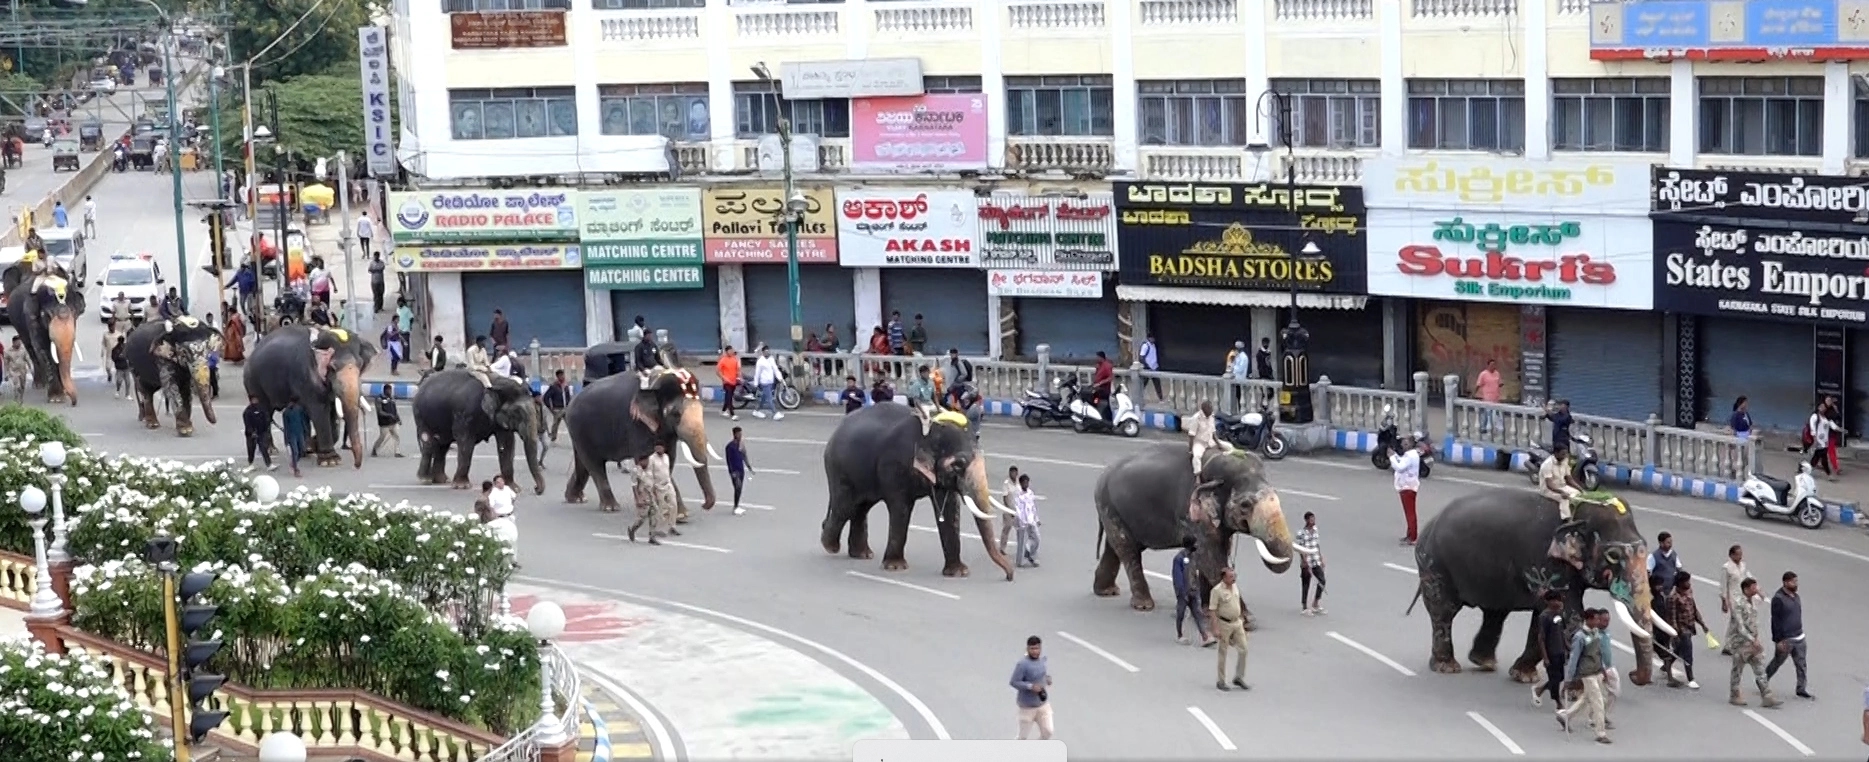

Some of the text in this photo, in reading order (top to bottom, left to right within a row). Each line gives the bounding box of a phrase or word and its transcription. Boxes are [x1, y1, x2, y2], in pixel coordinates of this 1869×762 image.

[370, 92, 386, 156] KSIC
[1740, 177, 1869, 212] ಎಂಪೋರಿ
[843, 193, 928, 219] ಆಕಾಶ್
[435, 213, 553, 227] RADIO PALACE
[713, 220, 761, 234] Pallavi
[587, 244, 697, 258] MATCHING CENTRE
[714, 250, 827, 258] MATCHING CNTRE
[885, 239, 970, 252] AKASH
[886, 255, 933, 264] MATCHING
[935, 255, 970, 264] CENTRE
[1150, 255, 1332, 281] BADSHA STORES
[1397, 245, 1616, 285] Sukri's
[589, 268, 700, 284] MATCHING CENTER
[1666, 253, 1750, 290] States
[1454, 281, 1571, 300] Silk Emporium
[1718, 300, 1866, 321] KARNATAKA STATE SILK EMPORIUM
